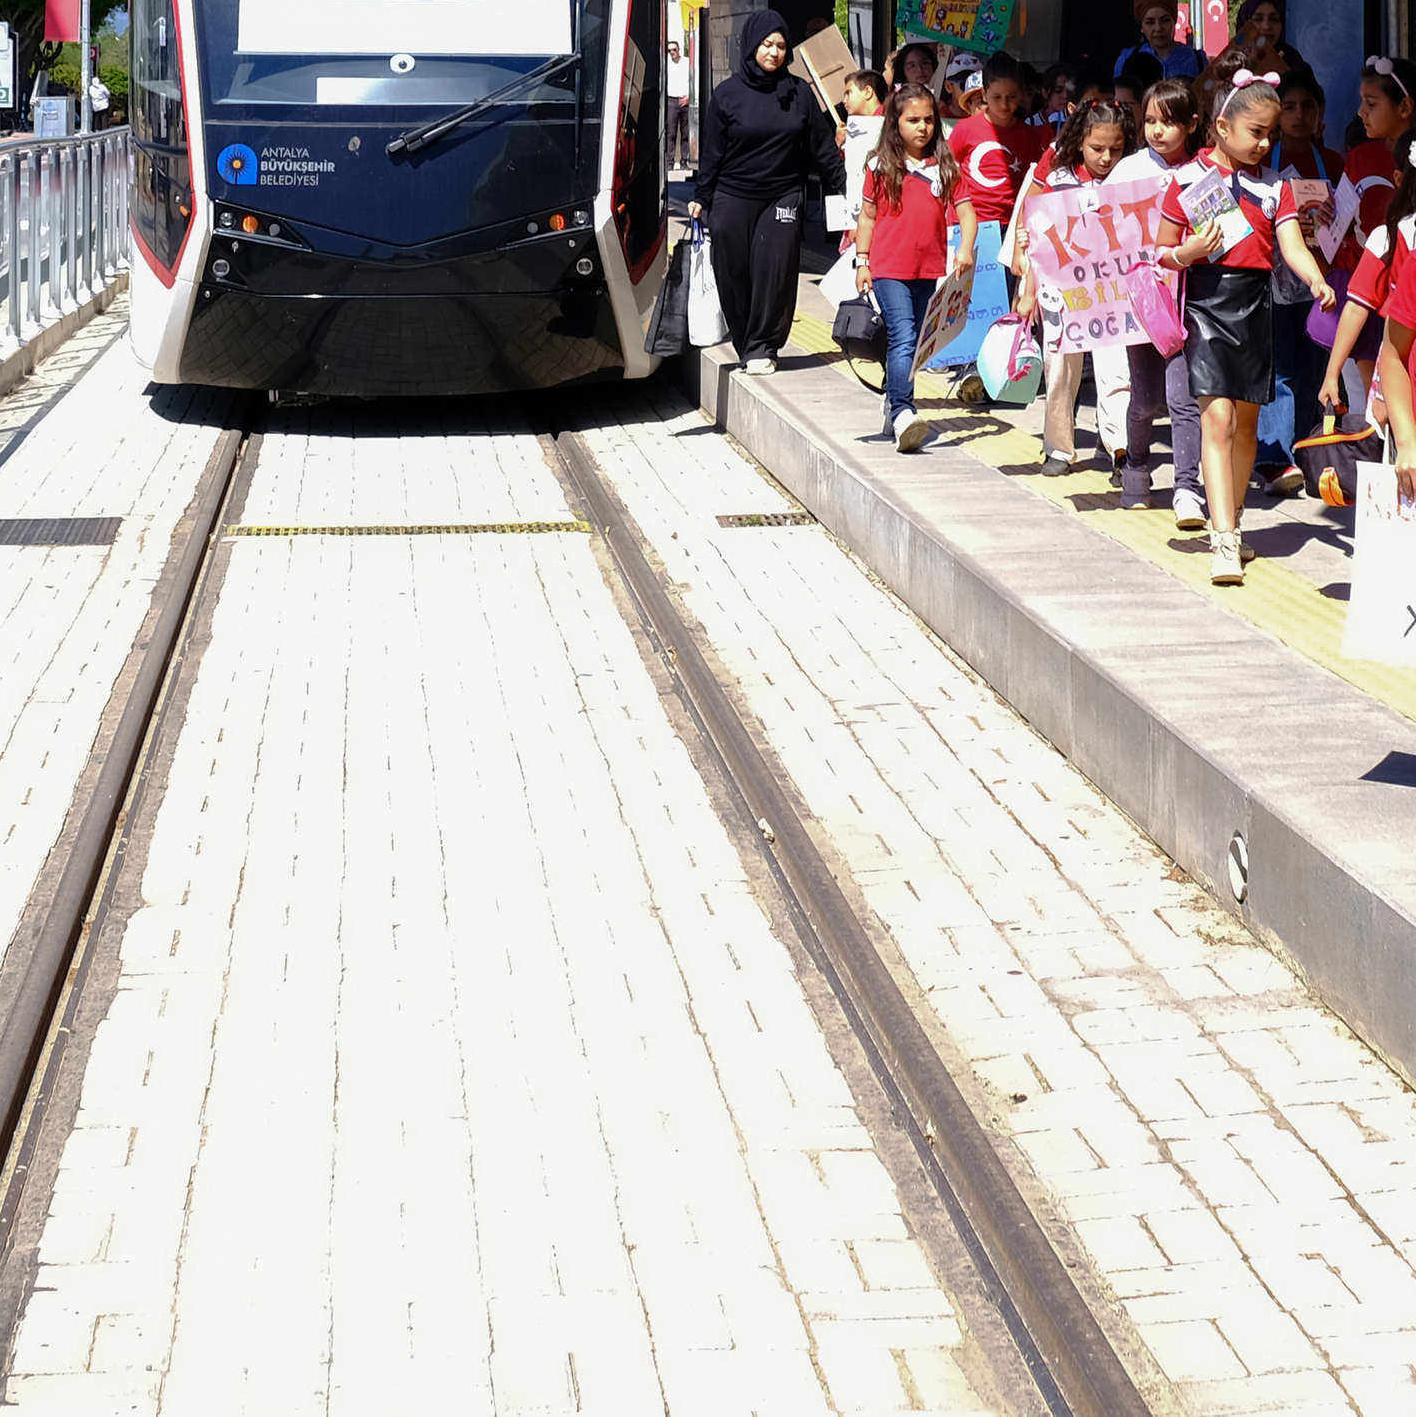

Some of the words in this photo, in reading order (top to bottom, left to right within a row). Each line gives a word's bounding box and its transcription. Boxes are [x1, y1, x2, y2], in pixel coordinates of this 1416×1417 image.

[260, 147, 310, 158] ANTALYA
[260, 159, 336, 174] BÜYÜKŞEHİR
[259, 173, 319, 186] BELEDİYESİ
